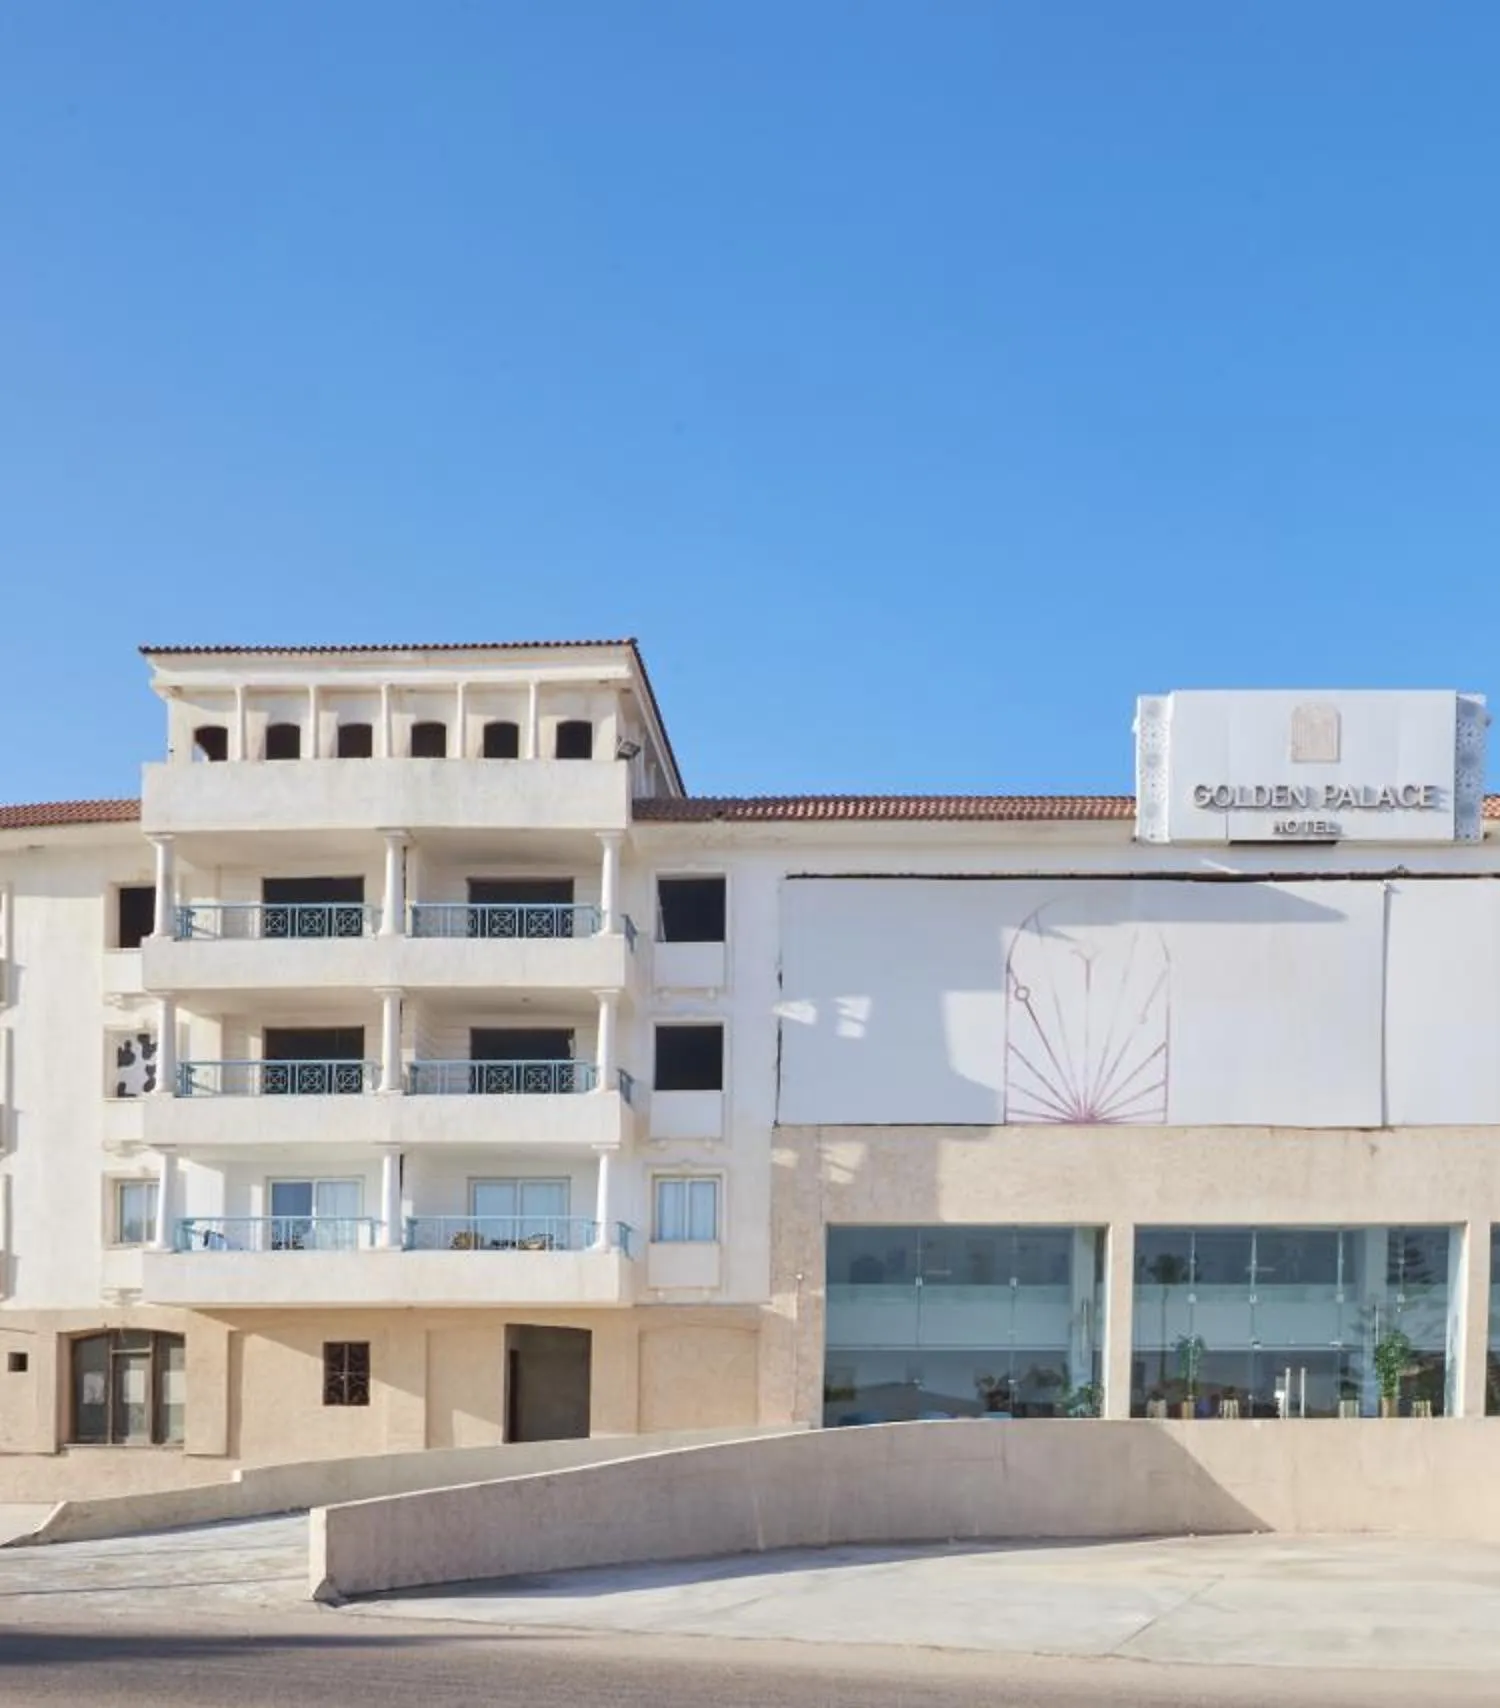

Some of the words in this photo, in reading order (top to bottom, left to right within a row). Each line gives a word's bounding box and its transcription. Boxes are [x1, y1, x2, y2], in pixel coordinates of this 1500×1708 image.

[1194, 784, 1309, 809] GOLDEN
[1322, 784, 1437, 809] PALACE
[1273, 819, 1338, 835] HOTEL
